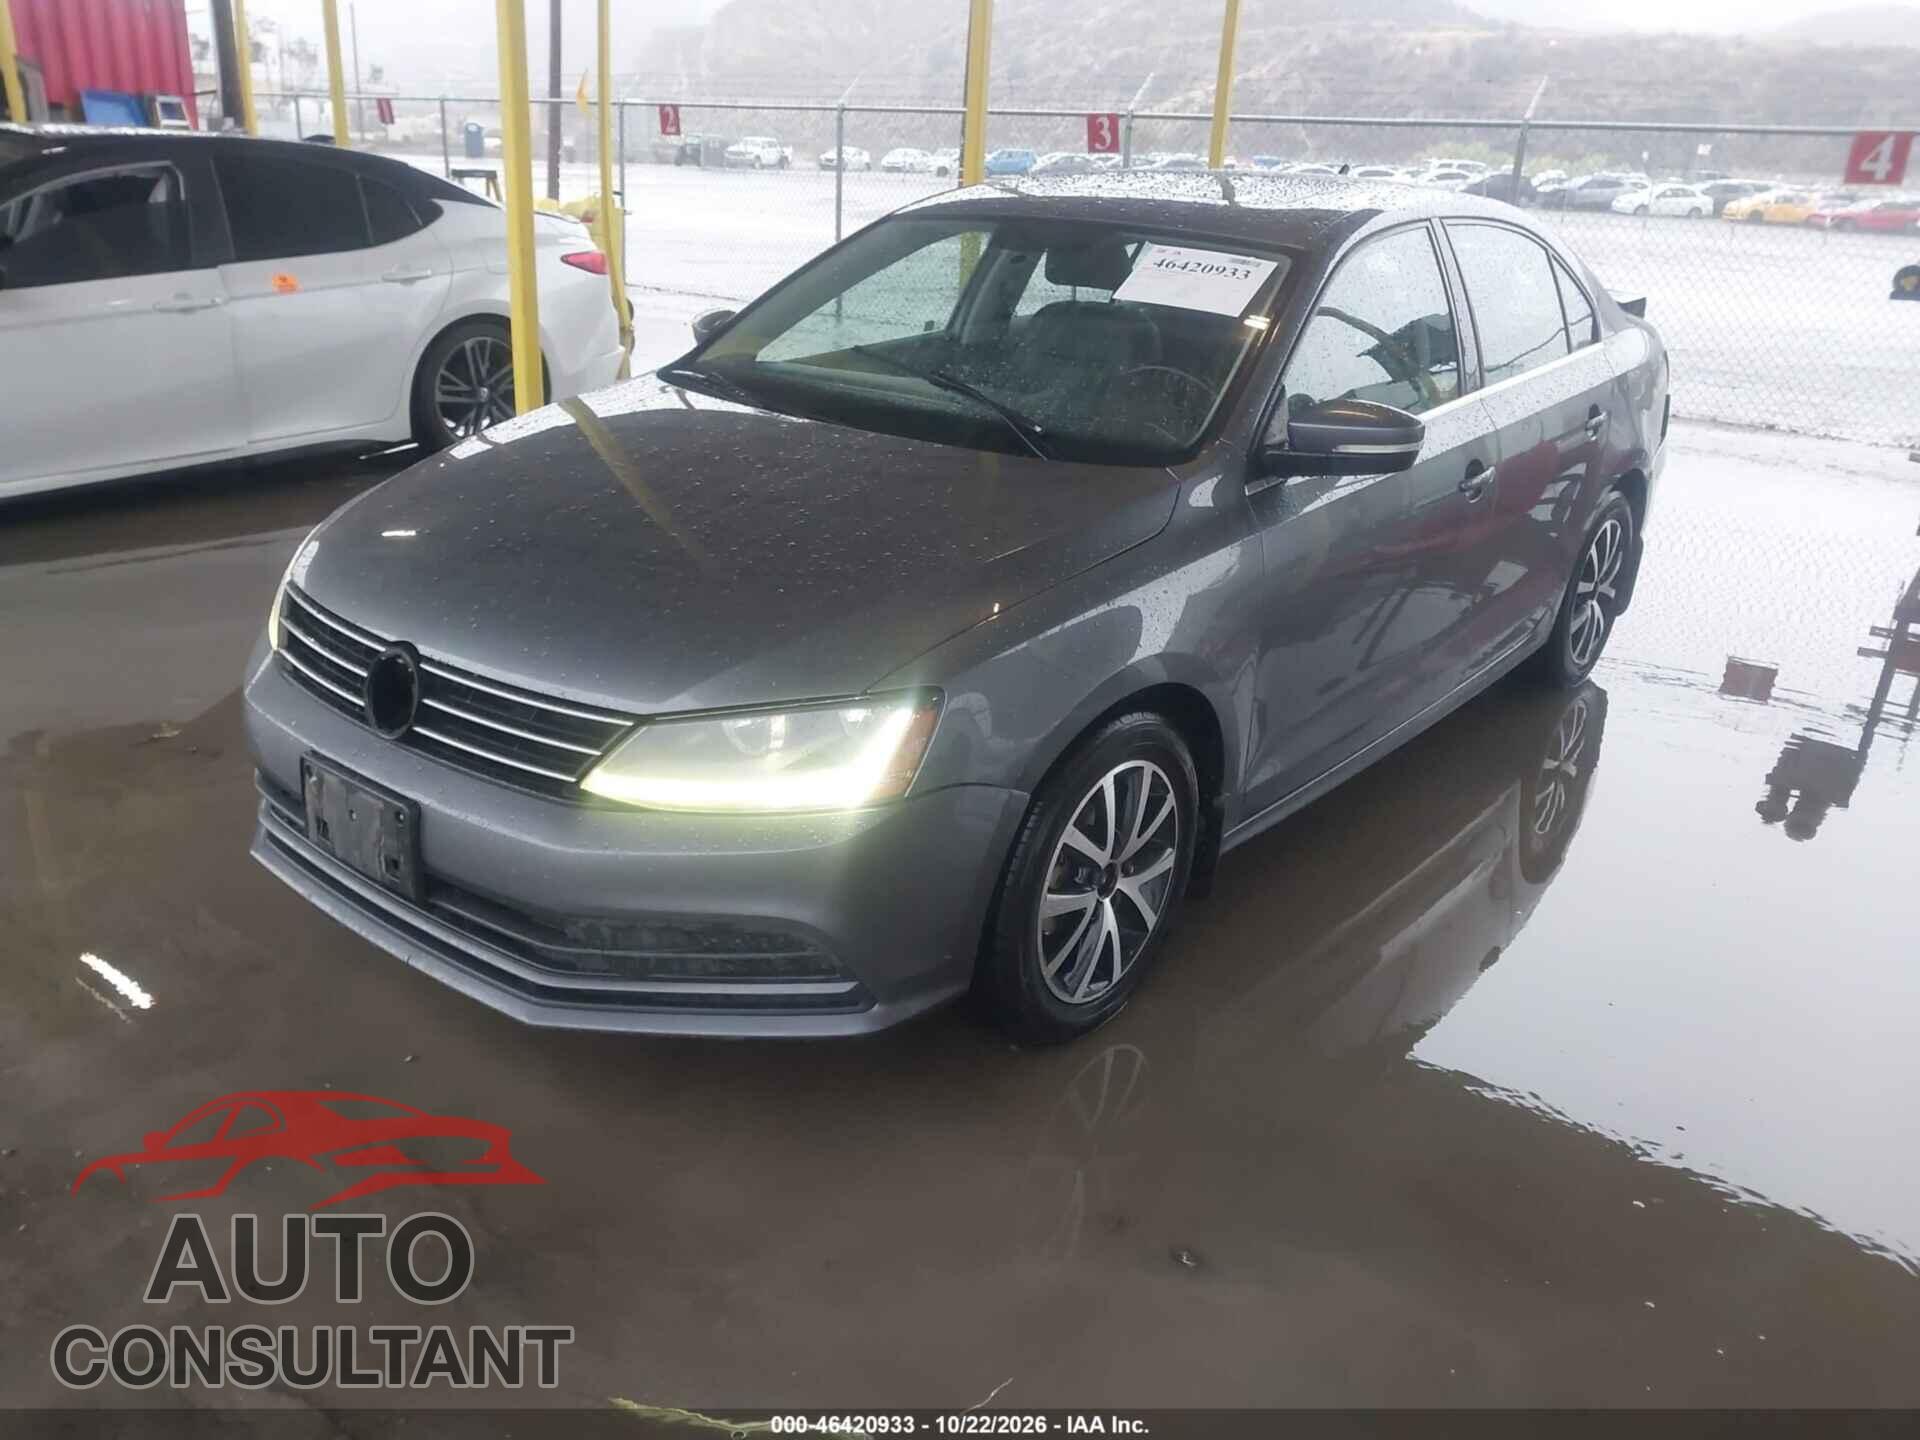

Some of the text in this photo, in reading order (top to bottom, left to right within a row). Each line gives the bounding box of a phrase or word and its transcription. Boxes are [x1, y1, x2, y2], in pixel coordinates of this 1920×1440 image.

[663, 106, 677, 132] 2
[1095, 117, 1111, 150] 3
[1859, 134, 1895, 180] 4
[1153, 258, 1251, 281] 46420933
